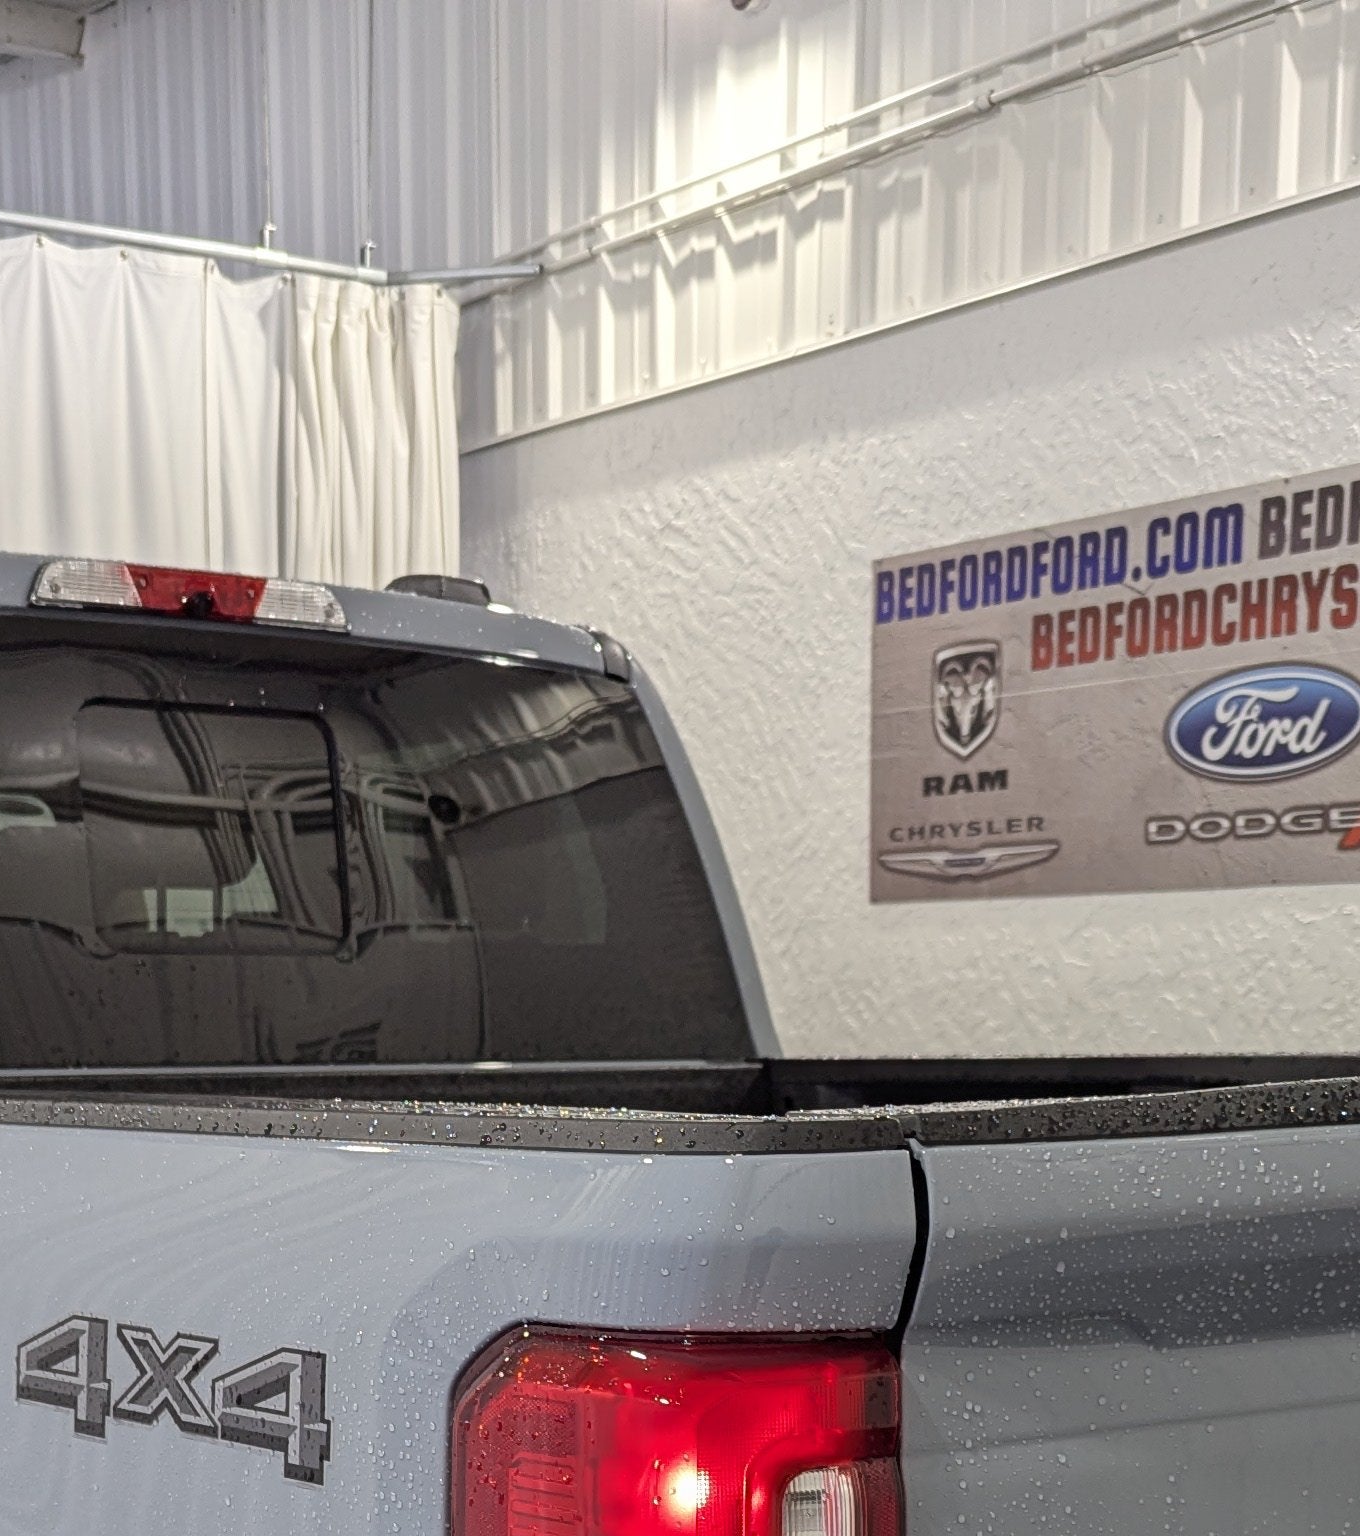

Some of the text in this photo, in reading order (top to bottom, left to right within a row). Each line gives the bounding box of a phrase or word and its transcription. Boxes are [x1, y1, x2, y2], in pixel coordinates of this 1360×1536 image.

[875, 503, 1244, 625] BEDFORDFORD.COM
[1201, 686, 1331, 761] Ford
[922, 768, 1008, 797] RAM
[889, 815, 1045, 843] CHRYSLER
